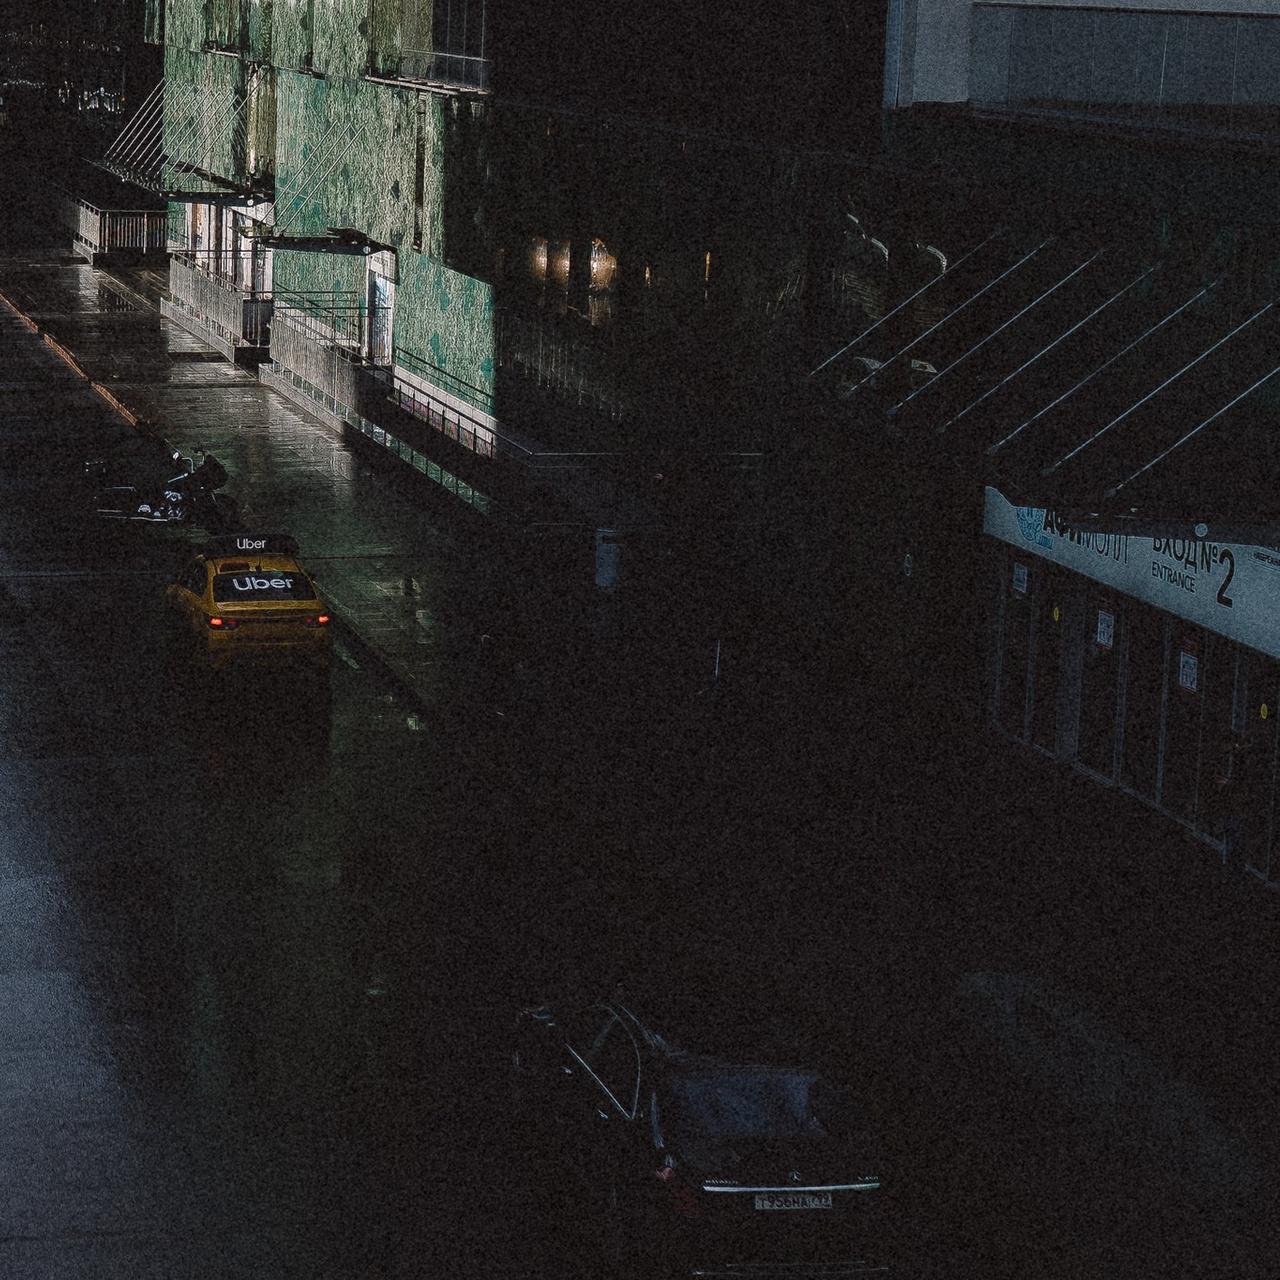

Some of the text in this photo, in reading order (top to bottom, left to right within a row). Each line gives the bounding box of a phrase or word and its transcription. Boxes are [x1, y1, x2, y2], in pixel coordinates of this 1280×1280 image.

[237, 538, 266, 549] Uber
[1153, 538, 1198, 574] ВХОД
[233, 577, 293, 591] Uber
[1152, 561, 1195, 593] ENTRANCE
